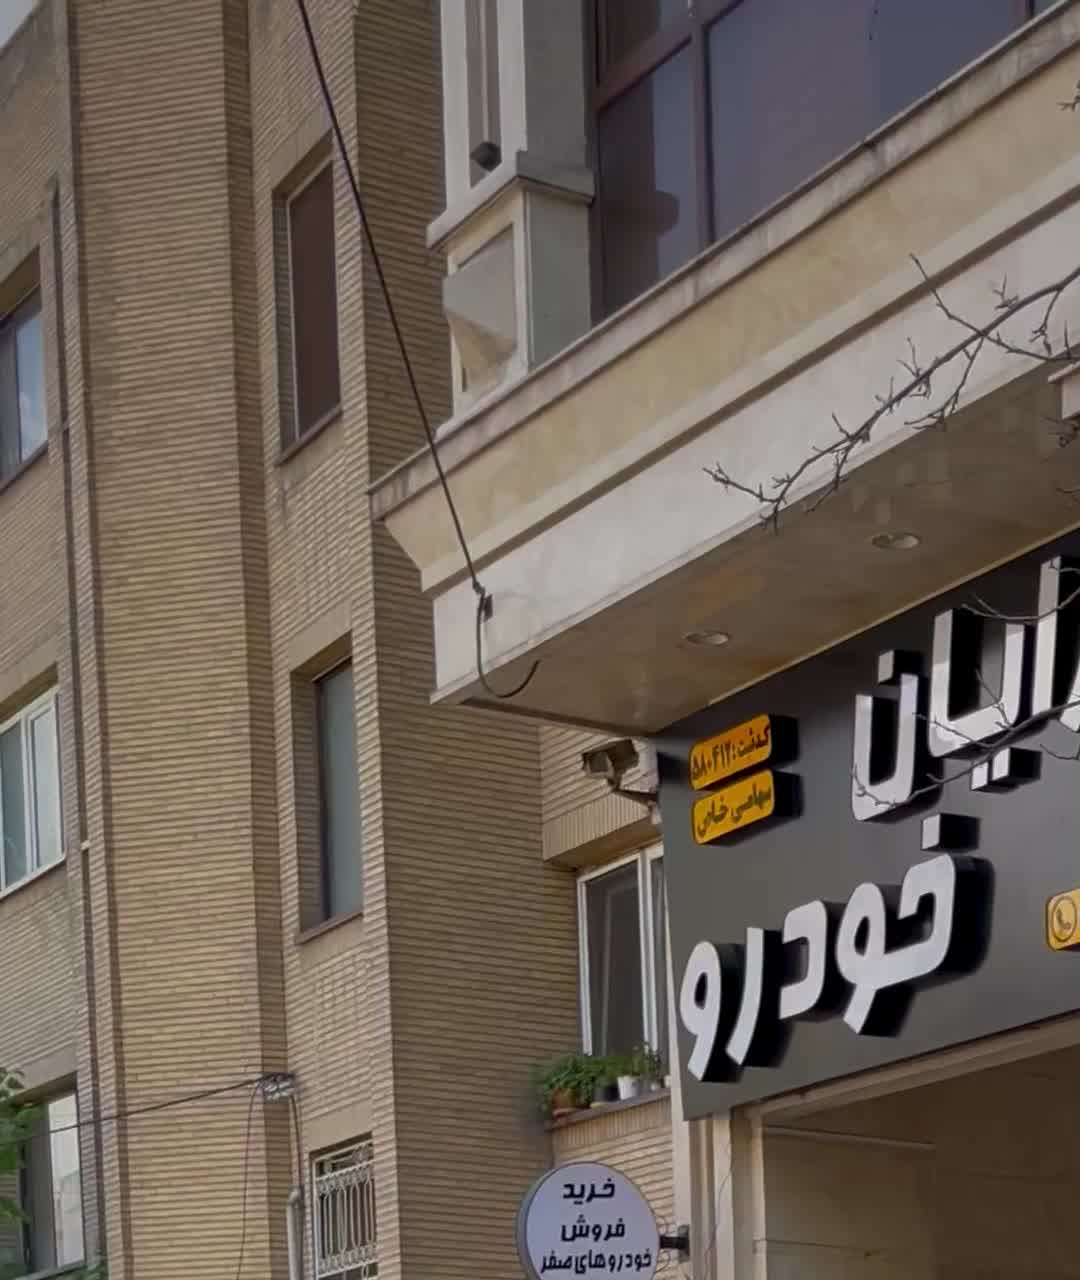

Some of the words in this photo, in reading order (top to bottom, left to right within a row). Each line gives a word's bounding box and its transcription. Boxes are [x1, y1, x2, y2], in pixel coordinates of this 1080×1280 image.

[697, 796, 729, 838] خاص
[730, 783, 772, 824] سهامی
[680, 813, 956, 1081] خودرو
[562, 1178, 616, 1205] خرید
[560, 1214, 626, 1242] فروش
[540, 1250, 573, 1274] صفر
